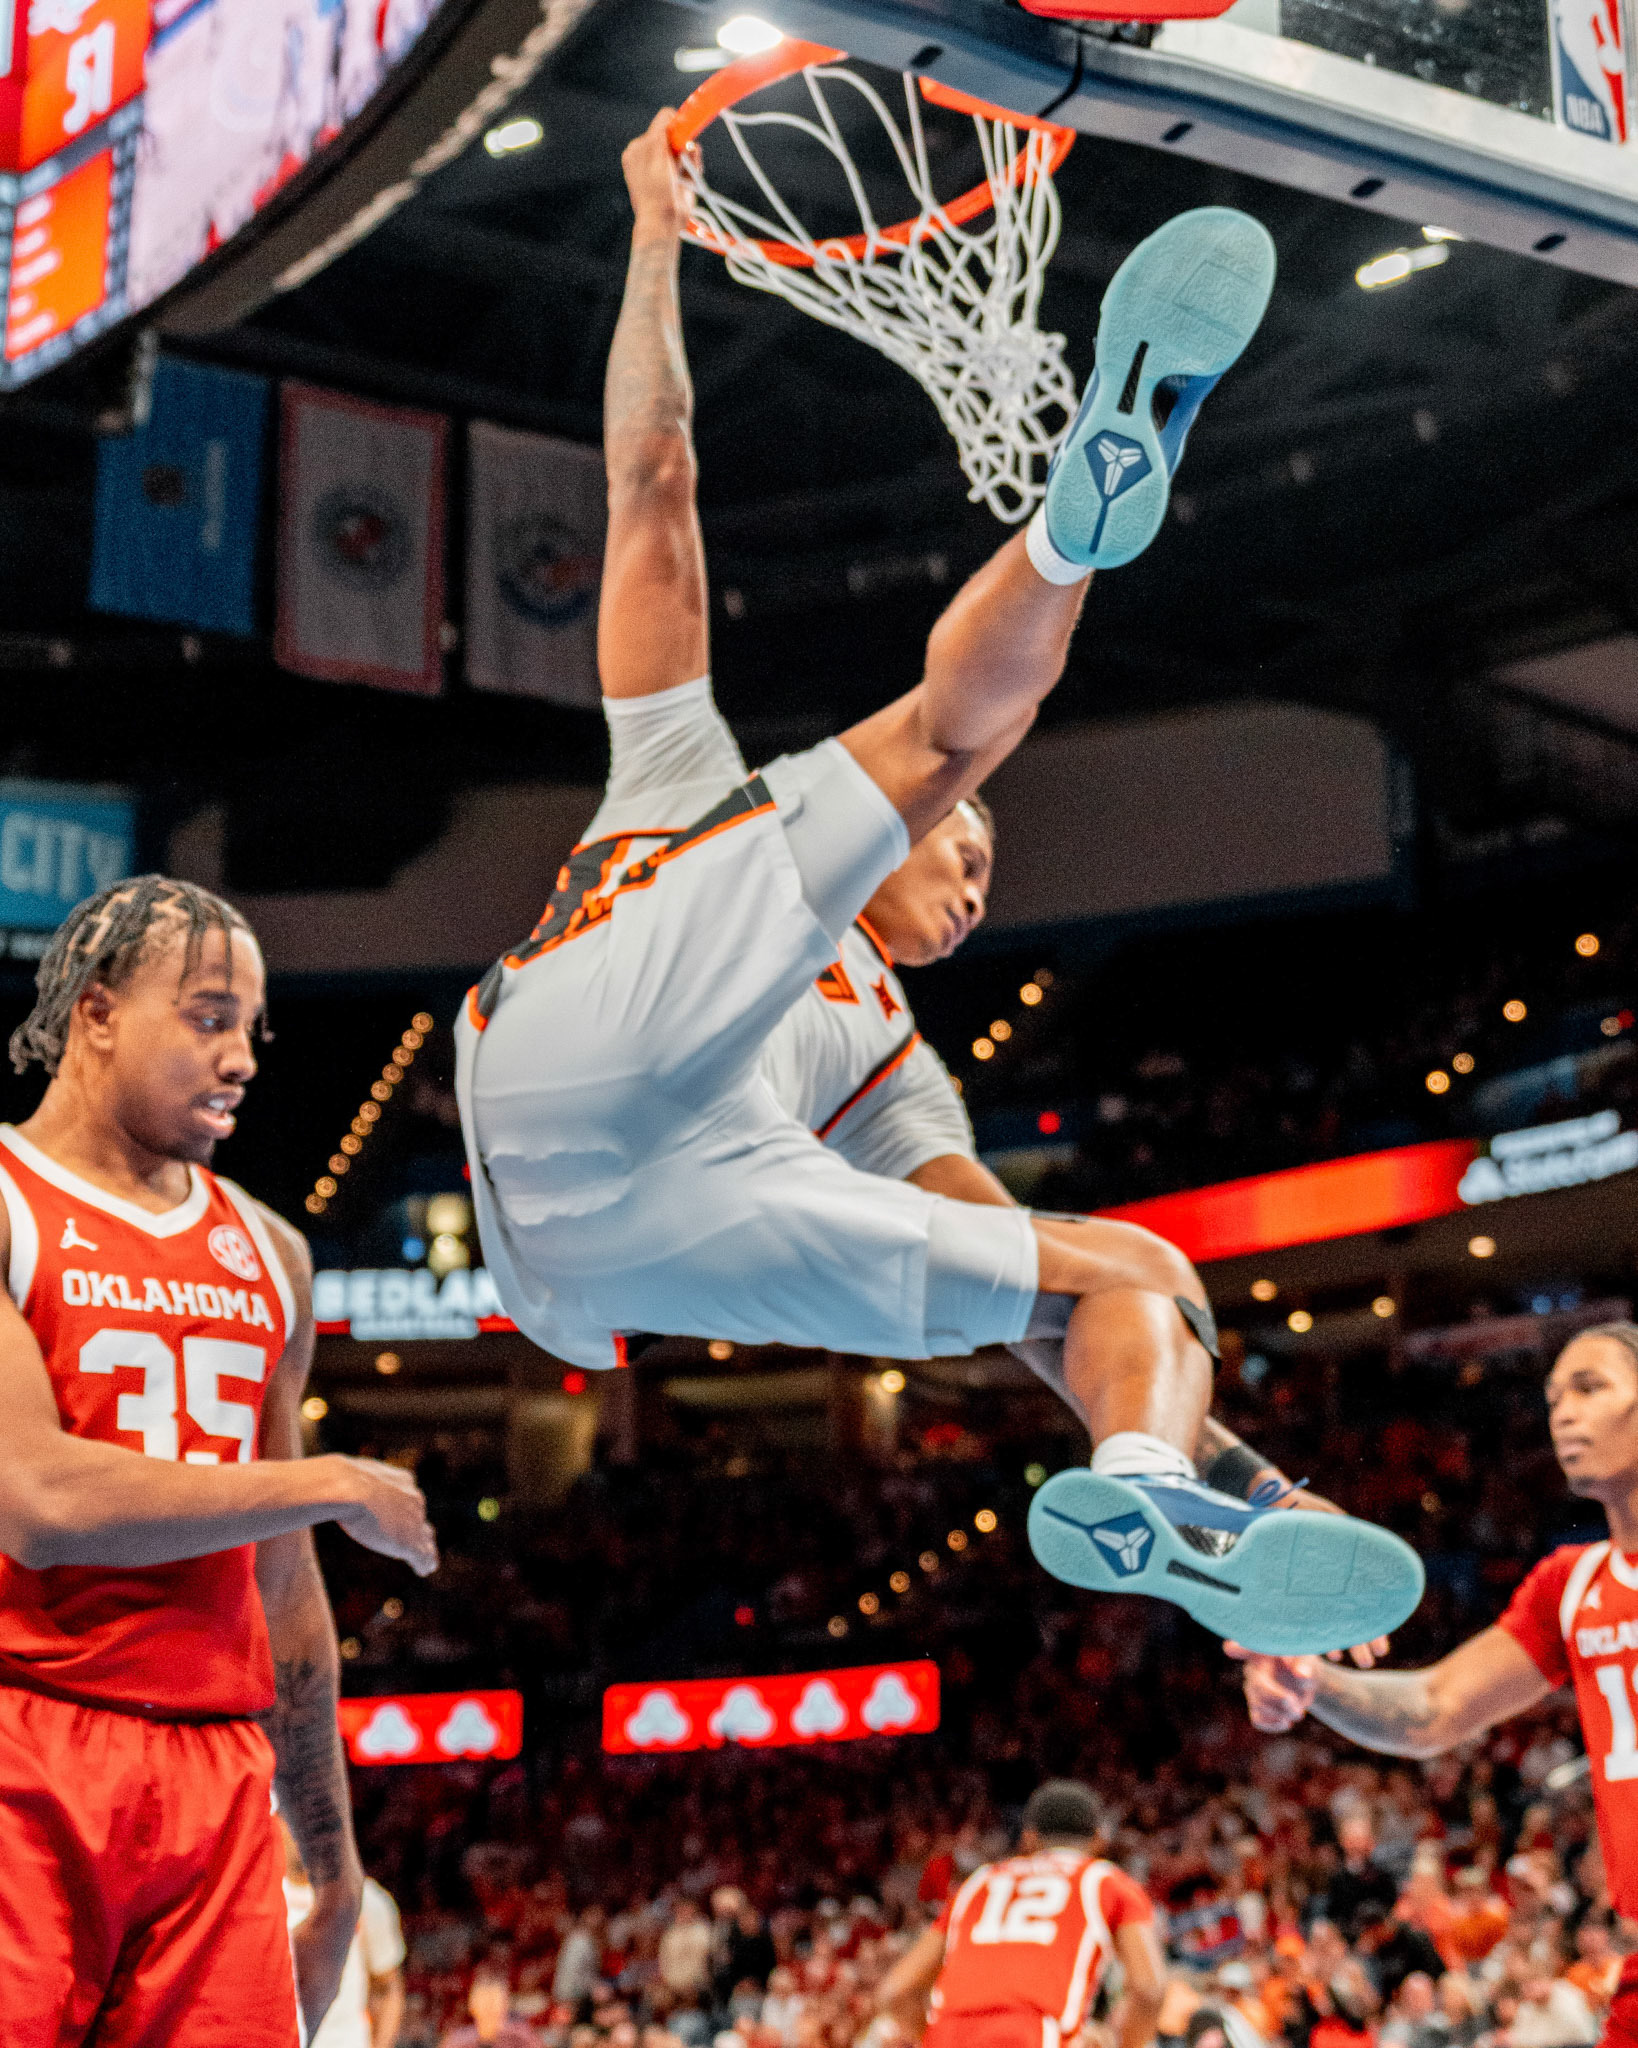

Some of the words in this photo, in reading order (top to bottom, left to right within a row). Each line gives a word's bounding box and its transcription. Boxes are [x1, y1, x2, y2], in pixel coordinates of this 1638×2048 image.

[1566, 93, 1605, 133] NBA
[2, 811, 127, 900] CITY
[211, 1228, 257, 1279] SEC
[62, 1268, 275, 1332] OKLAHOMA
[78, 1328, 266, 1464] 35
[1595, 1663, 1638, 1782] 1
[970, 1876, 1070, 1944] 12
